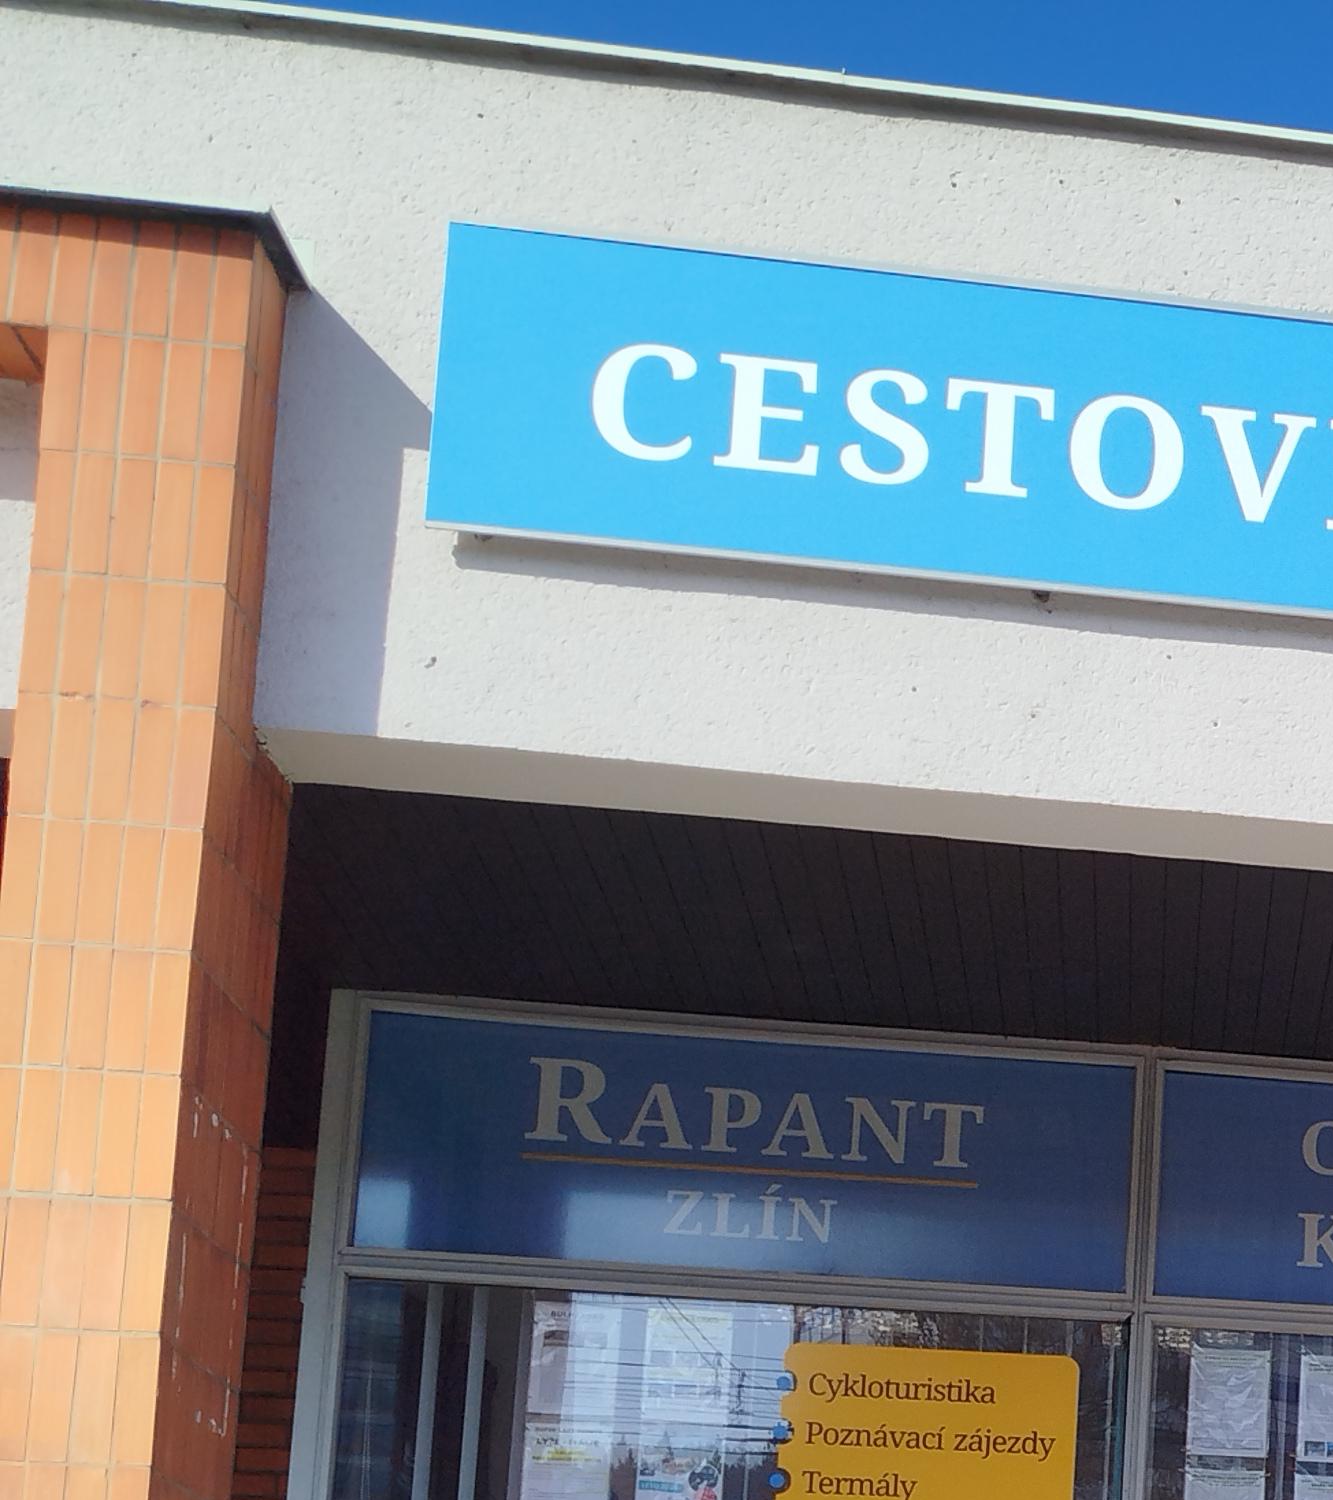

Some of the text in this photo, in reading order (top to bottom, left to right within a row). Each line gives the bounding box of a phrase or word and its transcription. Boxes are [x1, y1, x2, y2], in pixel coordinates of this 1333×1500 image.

[522, 1056, 986, 1169] RAPANT
[662, 1183, 838, 1244] ZLÍN
[808, 1372, 997, 1405] Cykloturistika
[804, 1420, 1057, 1462] Poznávací zájezdy
